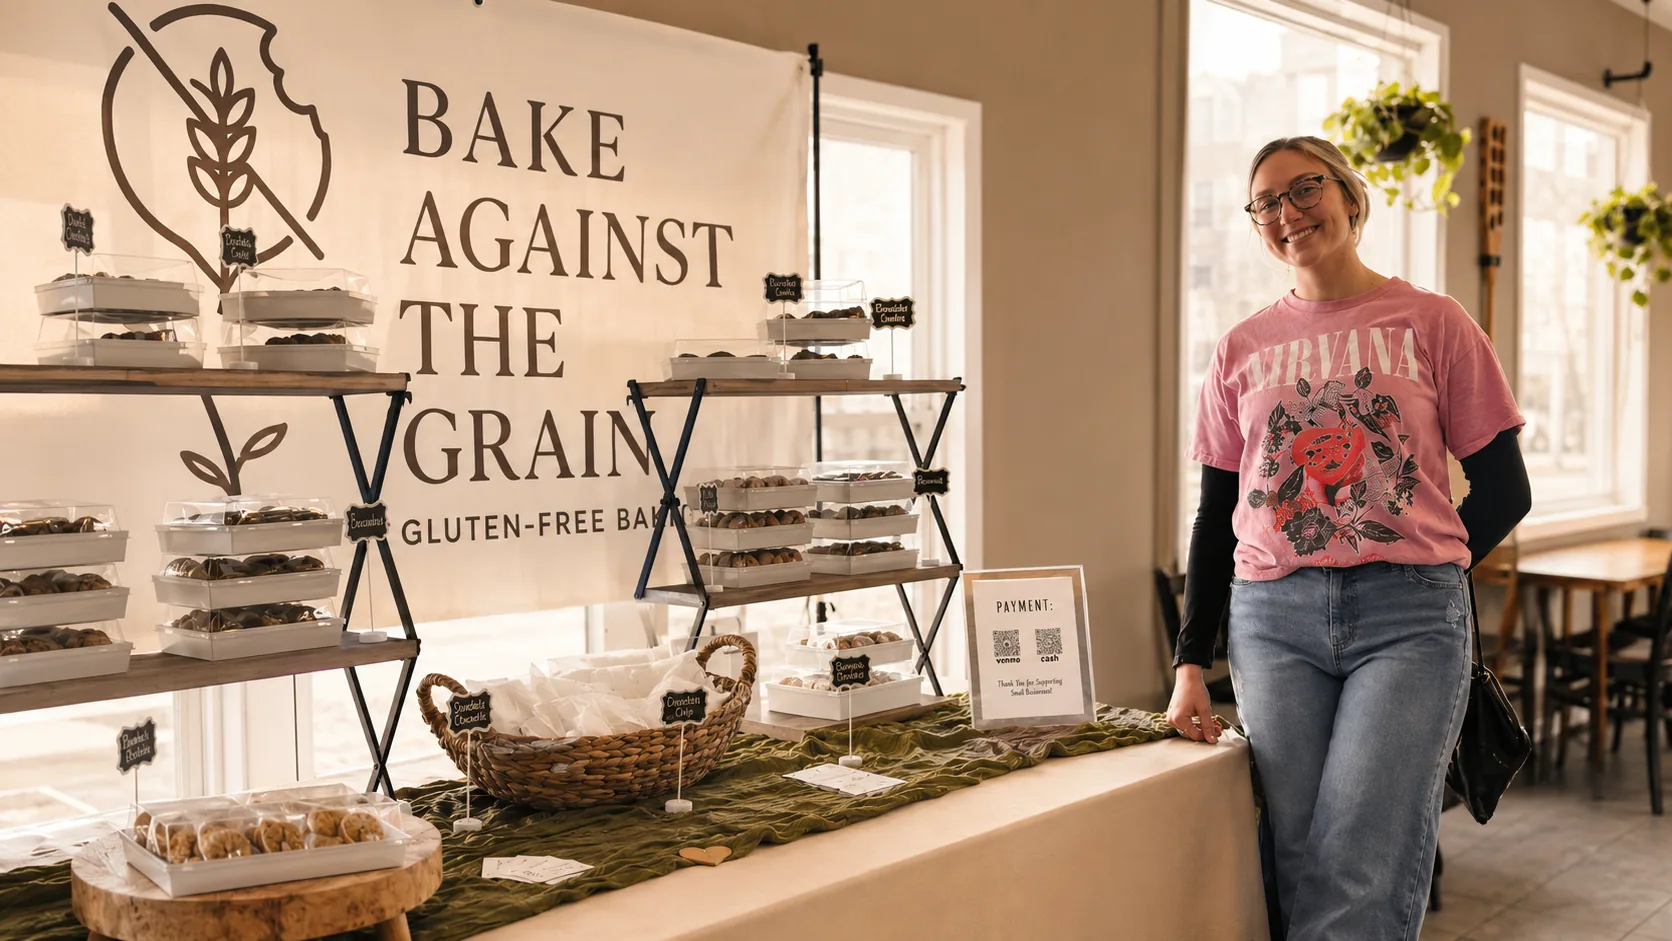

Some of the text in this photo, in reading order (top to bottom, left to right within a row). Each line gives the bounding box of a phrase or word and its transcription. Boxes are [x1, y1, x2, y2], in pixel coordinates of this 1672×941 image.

[402, 78, 625, 182] BAKE
[400, 190, 734, 288] AGAINST
[399, 299, 565, 378] THE
[1246, 327, 1419, 391] NIRVANA
[403, 407, 656, 485] GRAIN
[401, 508, 605, 545] GLUTEN-FREE
[996, 599, 1053, 613] PAYMENT:
[997, 679, 1014, 687] Thank
[1040, 654, 1059, 662] cash
